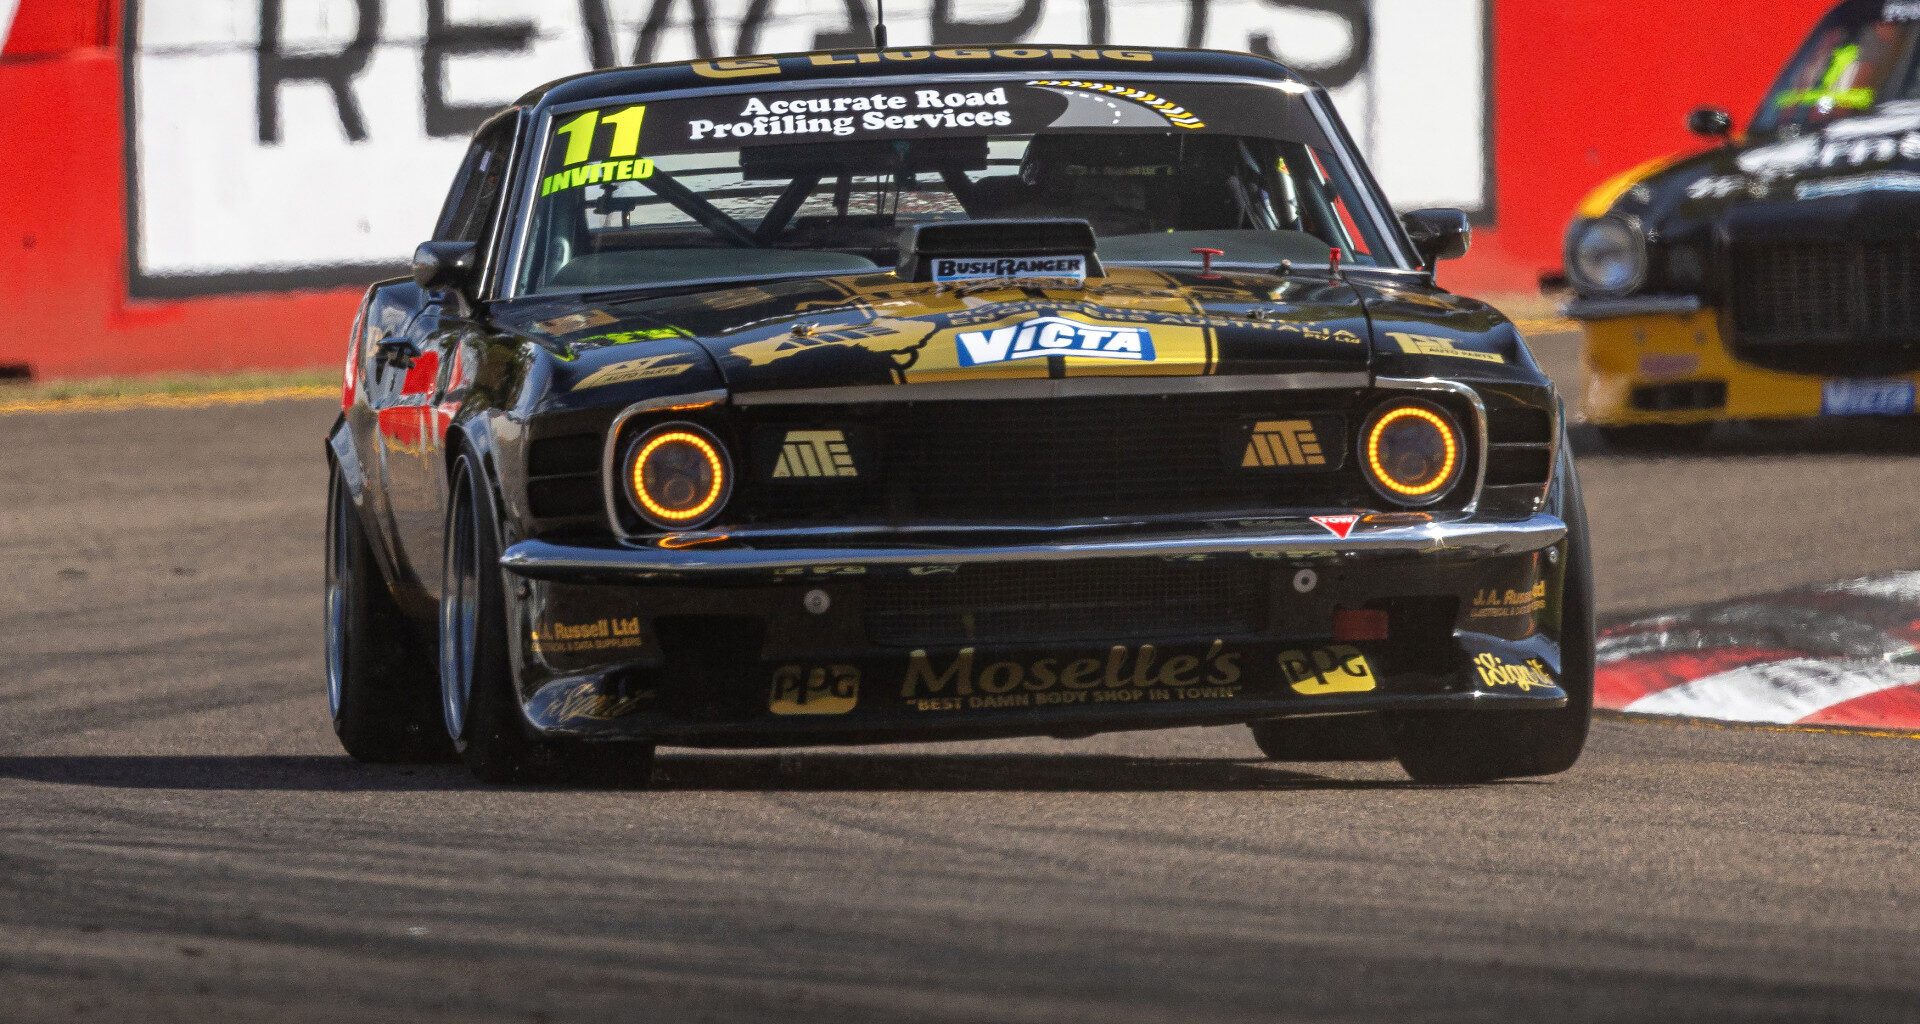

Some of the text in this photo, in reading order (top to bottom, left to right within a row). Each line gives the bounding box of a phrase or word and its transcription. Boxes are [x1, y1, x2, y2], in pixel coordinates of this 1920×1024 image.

[809, 49, 1154, 66] LIUGONG
[740, 87, 1009, 117] Accurate Road
[558, 105, 646, 166] 11
[688, 108, 1012, 140] Profiling Services
[541, 158, 654, 197] INVITED
[554, 618, 610, 640] Russell
[611, 616, 641, 637] Ltd
[901, 637, 1243, 698] Moselle's
[1283, 647, 1369, 686] PPG
[774, 664, 858, 706] PPG
[1034, 690, 1088, 706] BODY
[1092, 688, 1145, 703] SHOP
